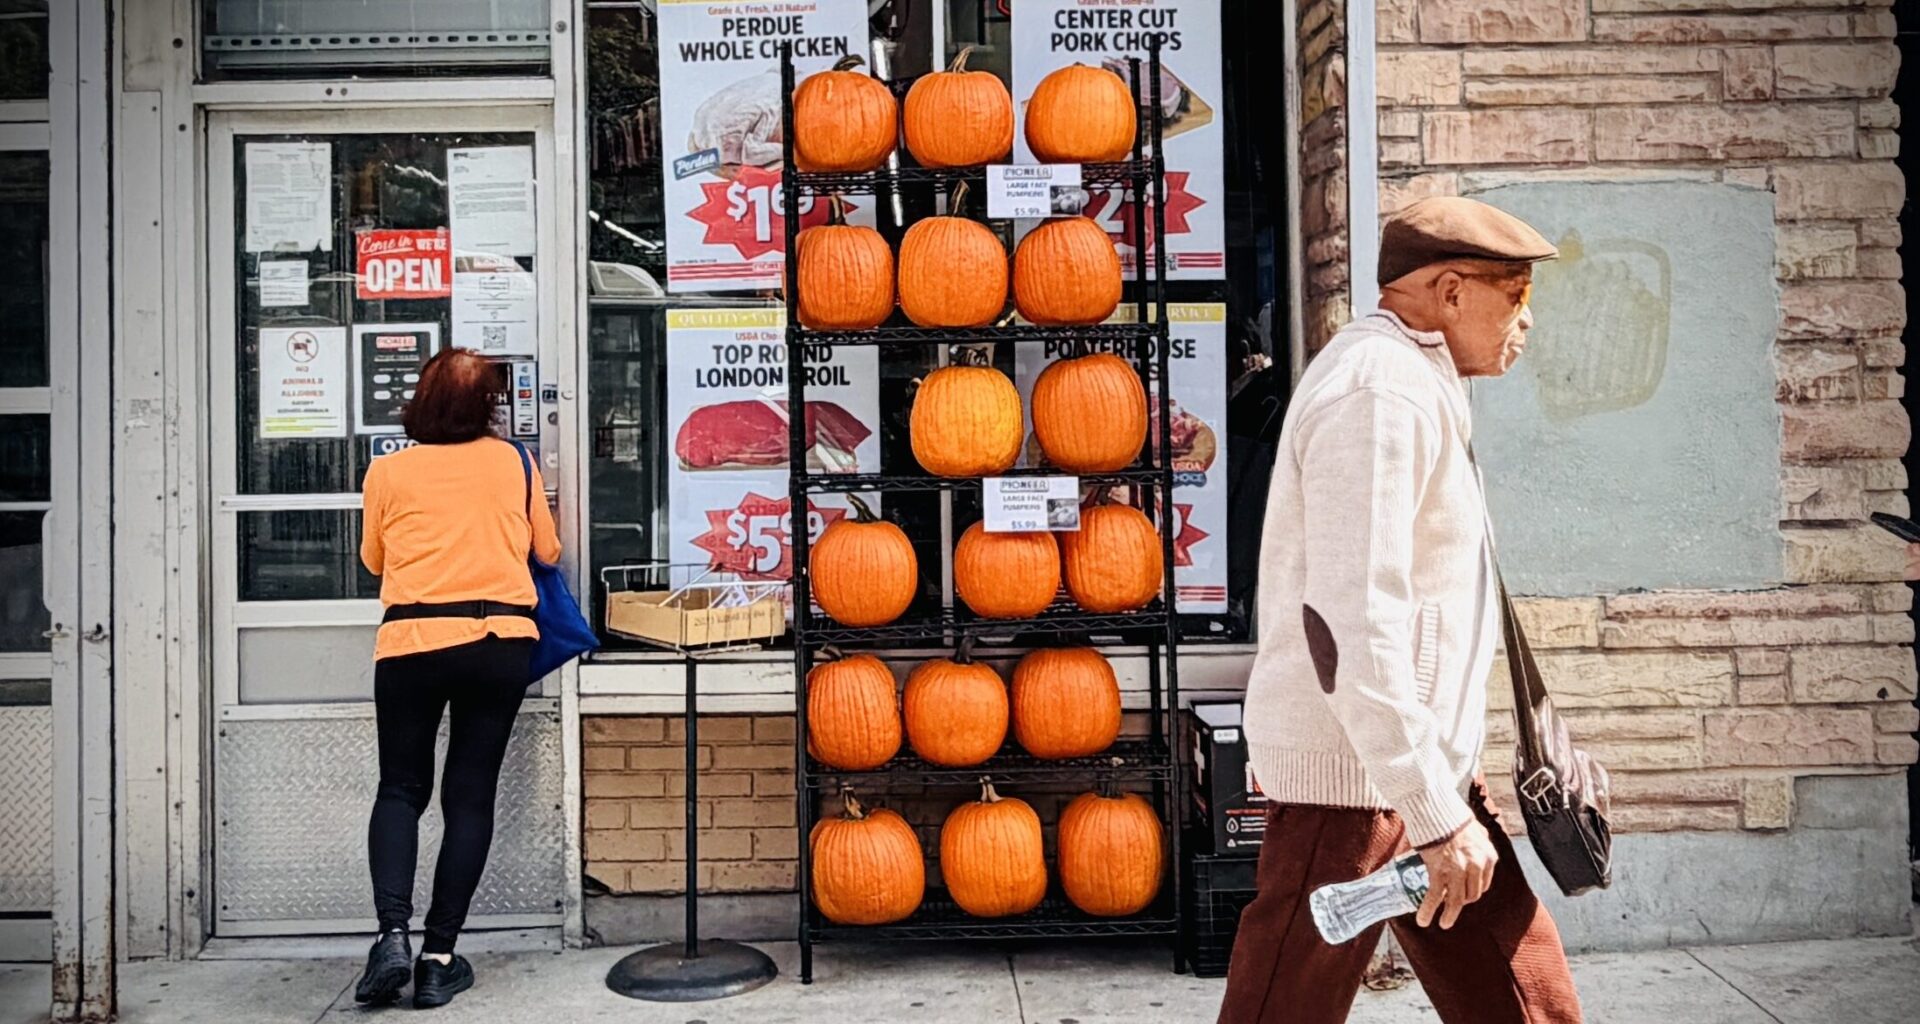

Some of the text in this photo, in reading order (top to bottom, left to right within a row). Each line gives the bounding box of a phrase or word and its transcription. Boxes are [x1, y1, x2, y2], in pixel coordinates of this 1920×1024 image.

[708, 7, 733, 15] Grade
[745, 5, 771, 14] Fresh,
[773, 4, 784, 12] All
[786, 3, 816, 12] Natural
[722, 15, 804, 37] PERDUE
[1054, 9, 1177, 29] CENTER CUT
[679, 36, 848, 62] WHOLE CHICKEN
[1051, 31, 1182, 52] PORK CHOPS
[676, 153, 716, 174] Perdue
[1004, 168, 1050, 177] PIONEER
[1014, 207, 1040, 216] $5.99
[360, 236, 396, 254] Come
[397, 235, 414, 247] in
[366, 258, 442, 293] OPEN
[679, 313, 739, 326] QUALITY
[735, 332, 758, 341] USDA
[712, 342, 833, 365] TOP ROND
[696, 366, 851, 388] LONDON ROIL
[1001, 480, 1047, 490] PIONEER
[1011, 520, 1037, 529] $5.99
